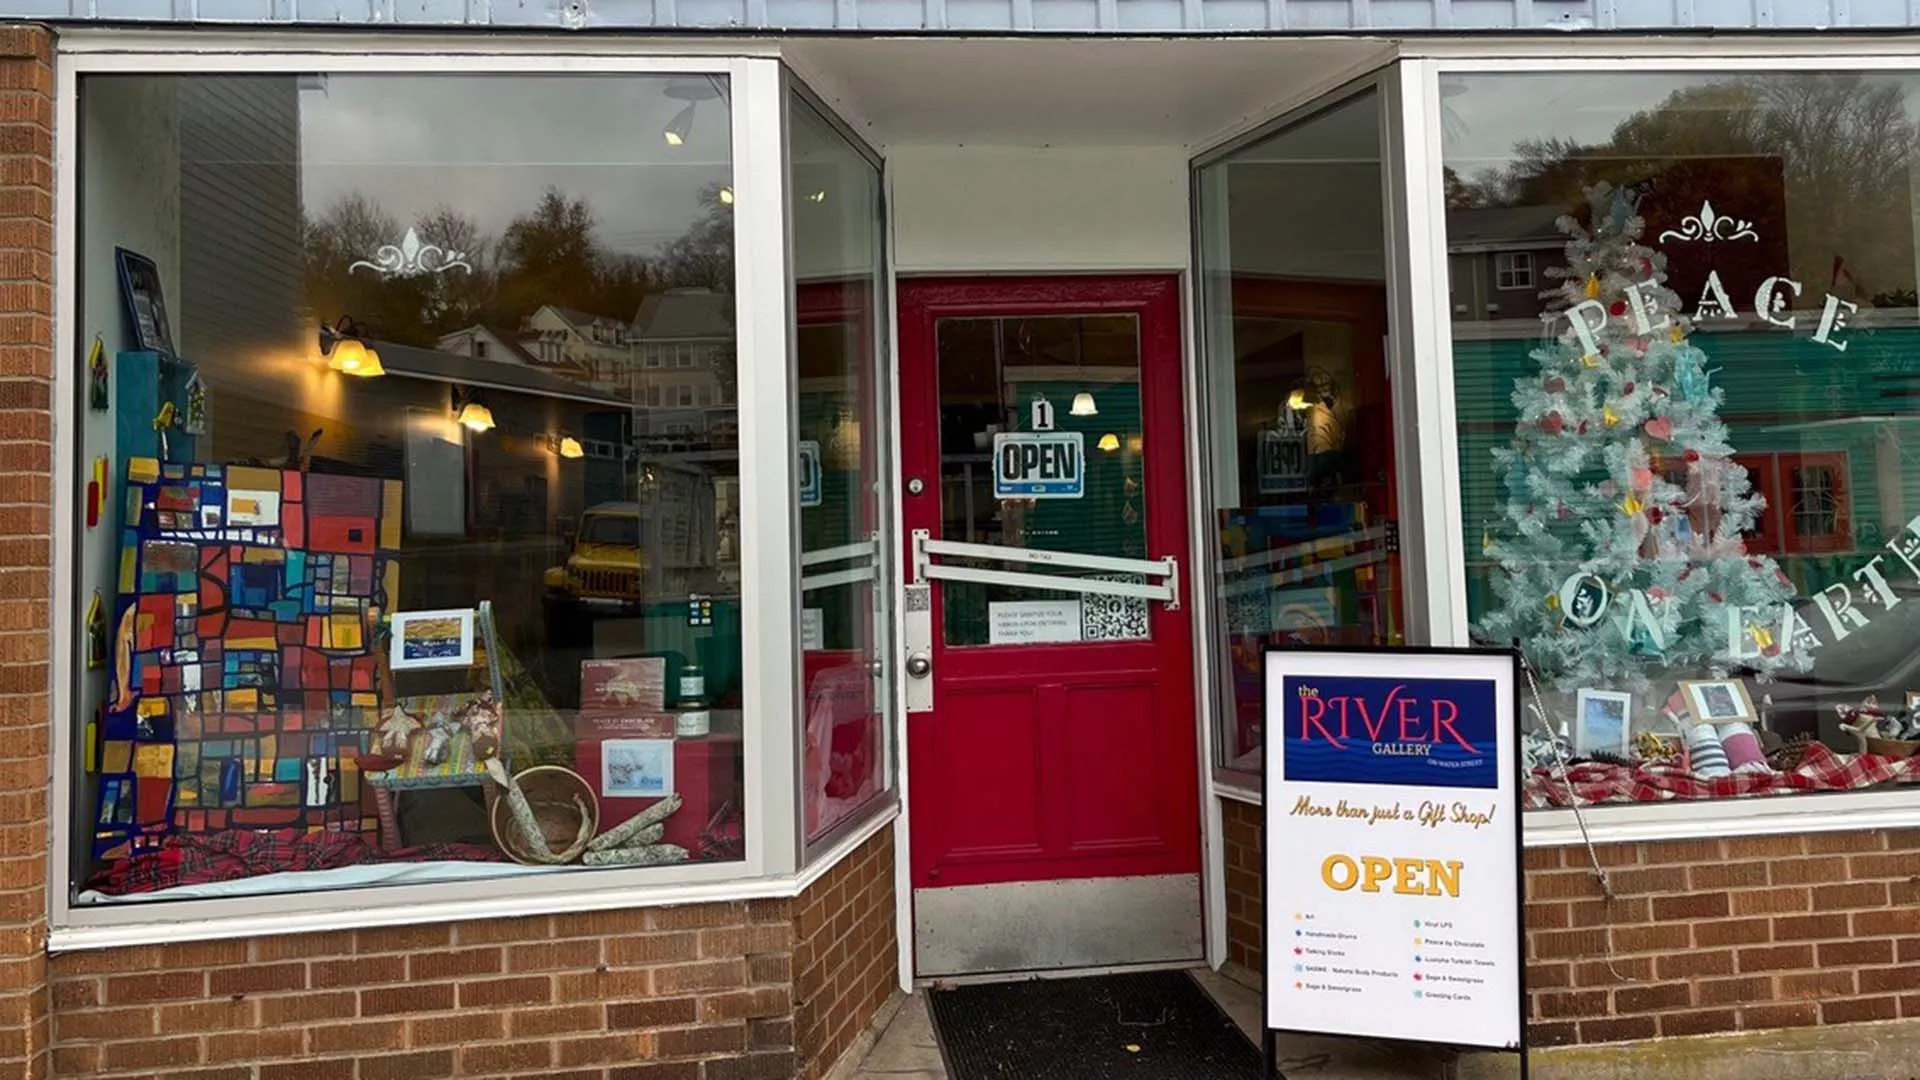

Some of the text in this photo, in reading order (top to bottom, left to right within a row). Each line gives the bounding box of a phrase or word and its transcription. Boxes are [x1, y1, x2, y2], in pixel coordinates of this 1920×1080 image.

[1563, 269, 1858, 357] PEACE
[1037, 402, 1048, 428] 1
[1002, 443, 1076, 480] OPEN
[1559, 572, 1668, 662] ON
[1298, 684, 1319, 698] the
[1299, 684, 1483, 754] RIVER
[1372, 742, 1432, 756] GALLERY
[1427, 758, 1437, 766] ON
[1460, 759, 1483, 767] STREET
[1290, 795, 1496, 829] More than just a Gift Shop!
[1321, 853, 1464, 898] OPEN
[1305, 930, 1337, 939] Handmade
[1424, 938, 1444, 946] Peace
[1454, 940, 1485, 949] Chocolate
[1305, 947, 1326, 956] Talking
[1474, 960, 1496, 968] Towels
[1355, 969, 1370, 977] Body
[1371, 970, 1399, 978] Products
[1448, 975, 1485, 984] Sweetgrass
[1305, 983, 1321, 991] Sage
[1327, 985, 1362, 993] Sweetgrass
[1425, 991, 1472, 1001] Greeting Cards
